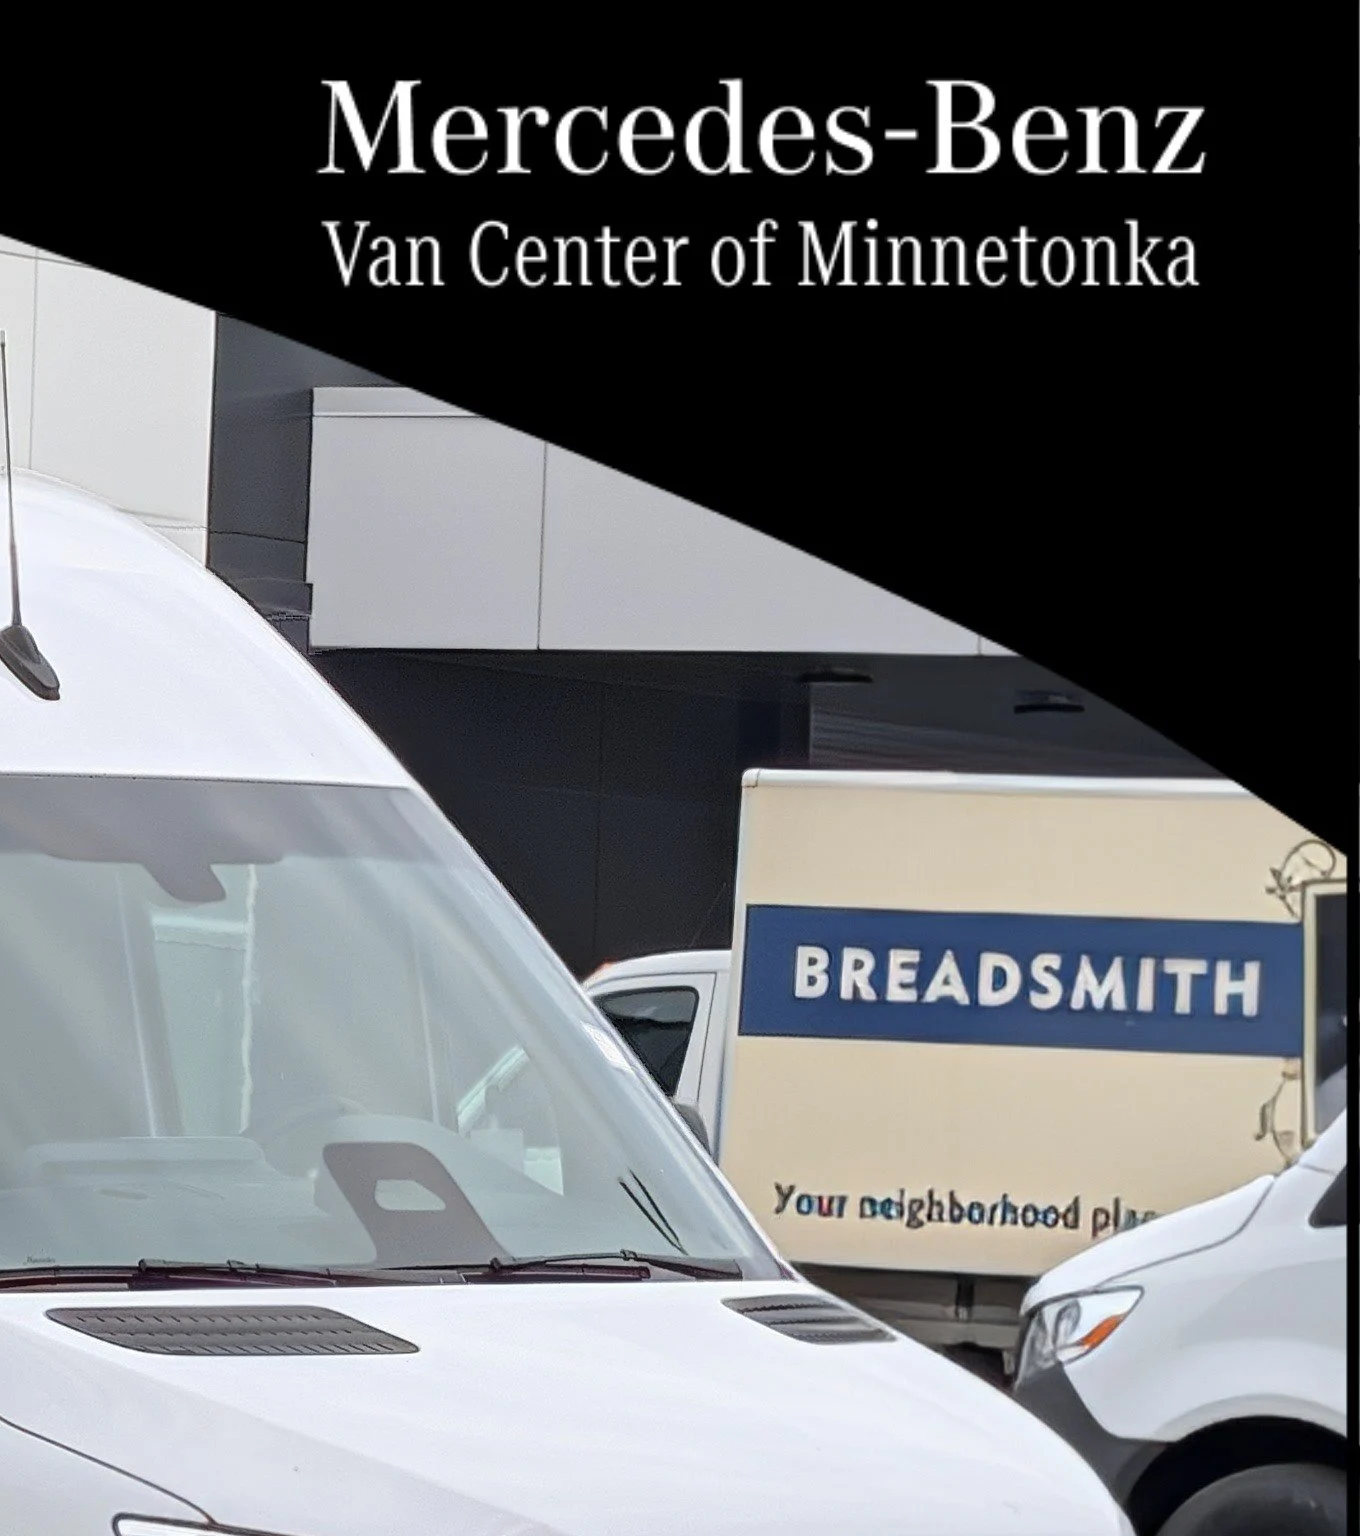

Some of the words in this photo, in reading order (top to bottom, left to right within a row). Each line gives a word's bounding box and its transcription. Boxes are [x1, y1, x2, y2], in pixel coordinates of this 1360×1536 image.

[793, 944, 1261, 1018] BREADSMITH
[774, 1182, 847, 1217] Your
[859, 1187, 1079, 1230] neighborhood
